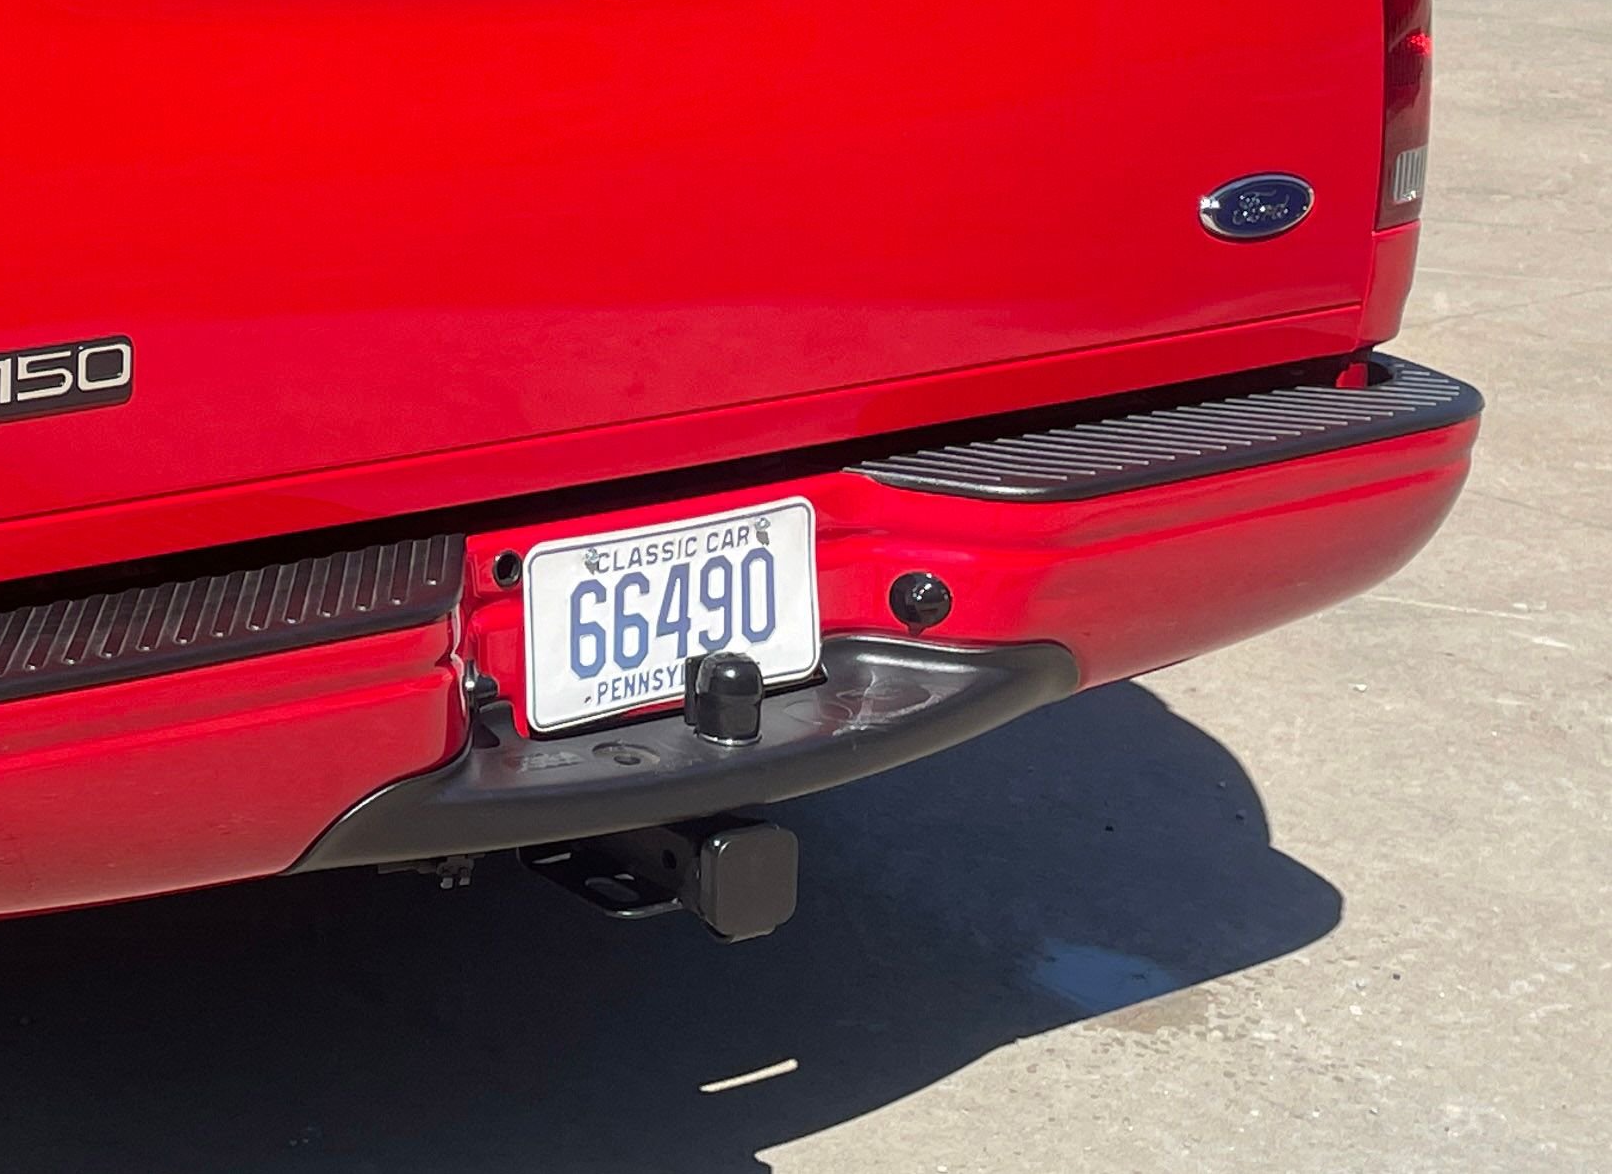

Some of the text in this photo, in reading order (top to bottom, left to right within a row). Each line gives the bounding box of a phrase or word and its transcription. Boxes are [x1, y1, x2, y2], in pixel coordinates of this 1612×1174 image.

[595, 525, 751, 575] CLASSIC CAR
[569, 547, 777, 680] 66490
[597, 663, 686, 705] PENNSYL
